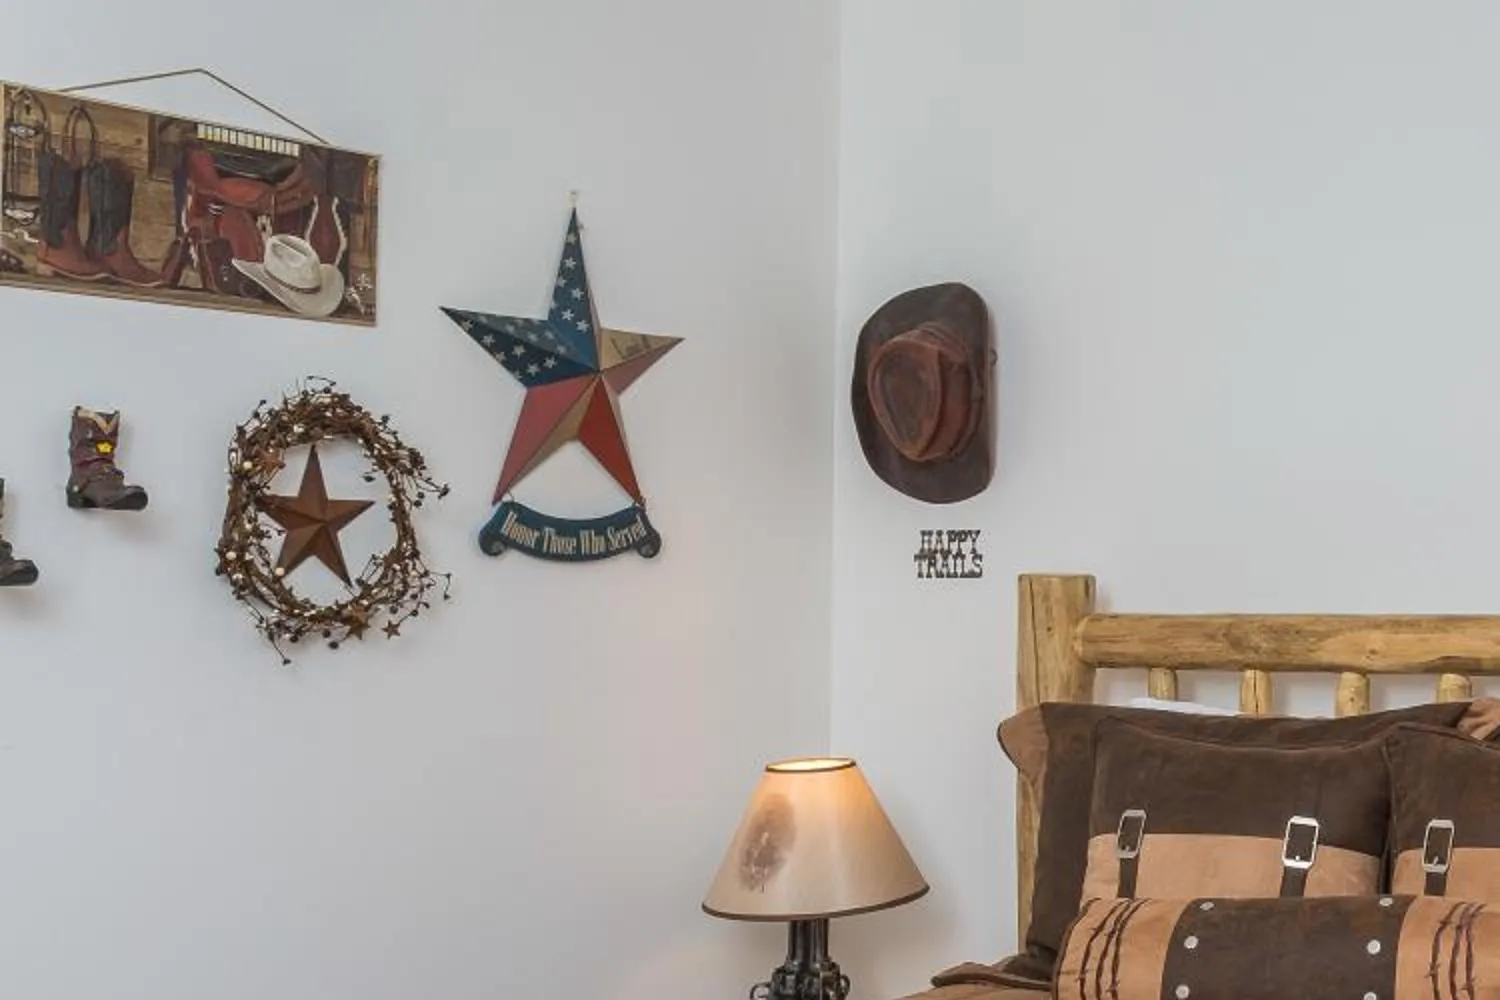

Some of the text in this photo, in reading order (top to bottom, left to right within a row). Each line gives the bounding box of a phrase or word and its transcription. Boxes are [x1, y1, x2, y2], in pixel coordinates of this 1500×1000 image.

[502, 511, 646, 556] Honor Those Who Served
[920, 529, 981, 554] HAPPY
[914, 553, 983, 579] TRAILS
